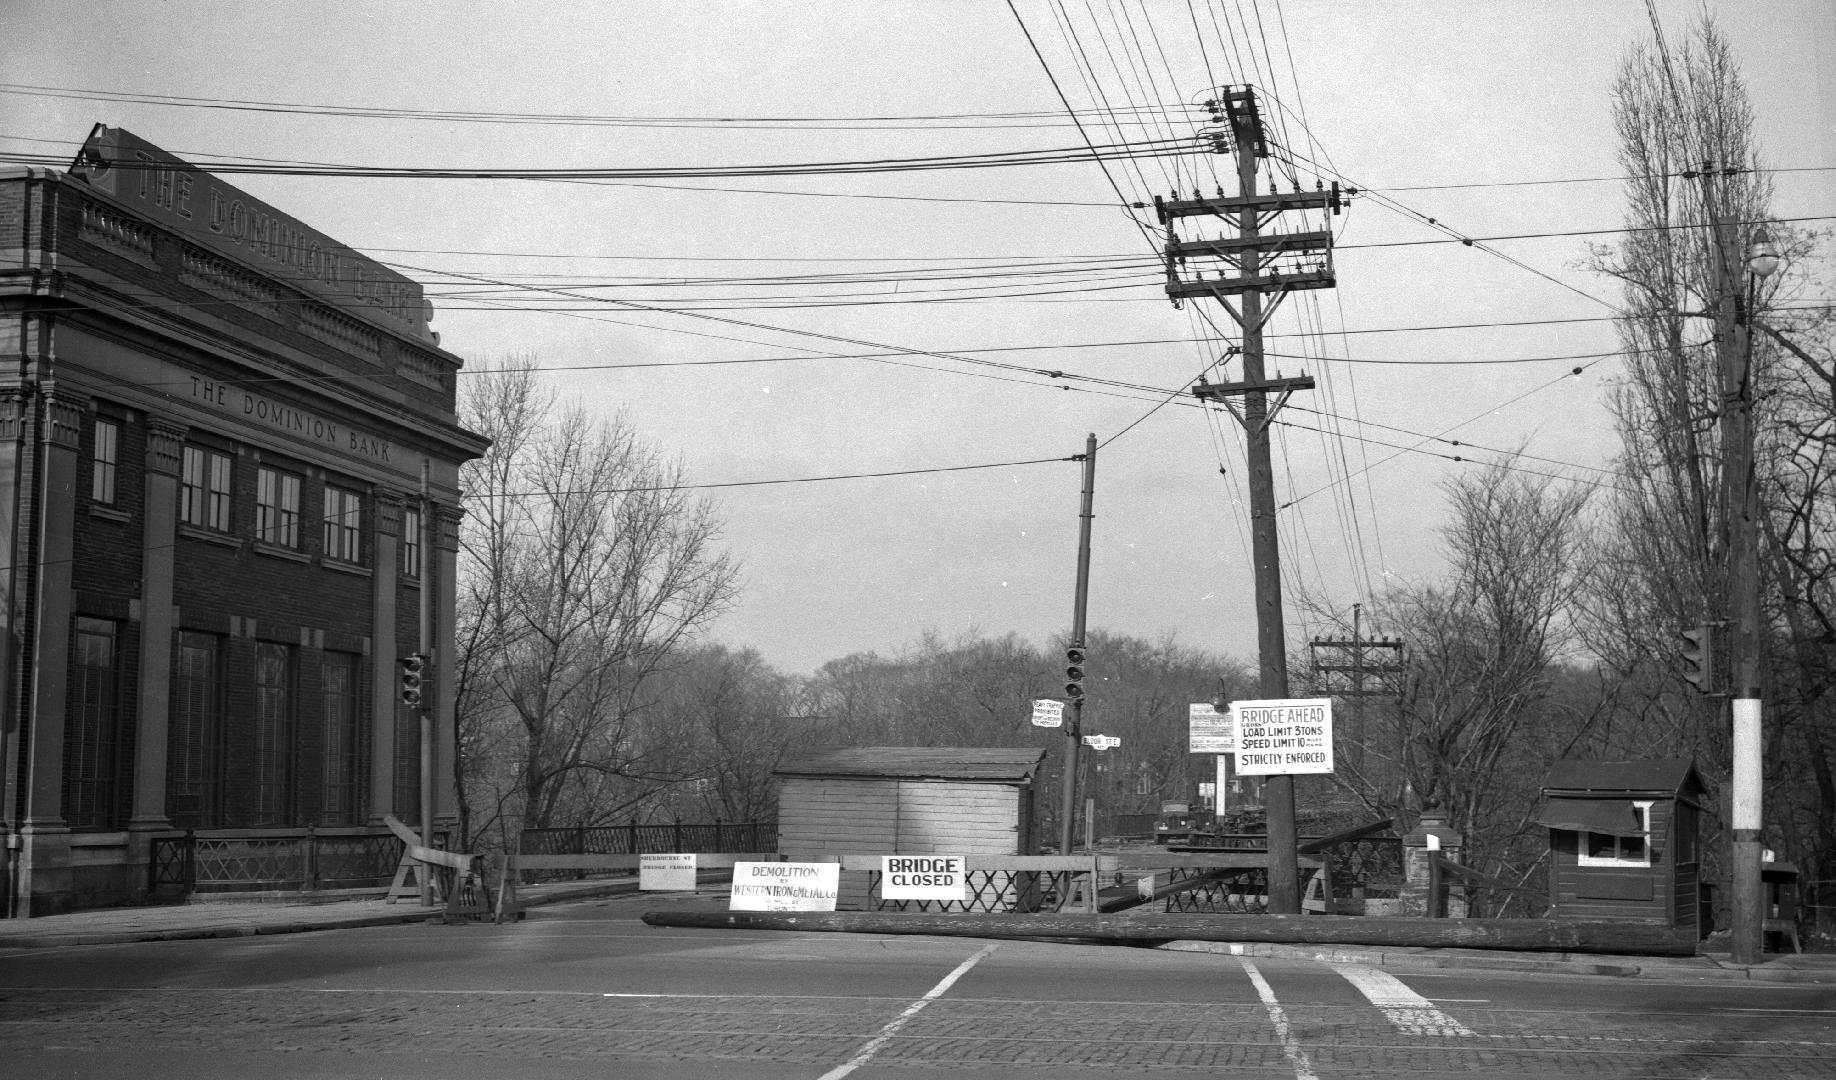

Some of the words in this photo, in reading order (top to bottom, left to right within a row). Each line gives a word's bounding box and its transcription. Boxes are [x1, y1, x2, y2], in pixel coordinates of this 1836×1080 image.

[136, 149, 194, 221] THE
[209, 186, 343, 291] DOMINION
[191, 376, 227, 405] THE
[244, 395, 337, 442] DOMINION
[349, 431, 391, 462] BANK
[1241, 709, 1285, 724] BRIDGE
[1287, 707, 1325, 723] AHEAD
[1242, 727, 1266, 738] LOAD
[1268, 726, 1293, 737] LIMIT
[1242, 739, 1270, 749] SPEED
[1273, 738, 1297, 748] LIMIT
[1298, 737, 1305, 747] 10
[1241, 753, 1282, 766] STRICTLY
[1286, 752, 1326, 764] ENFORCED
[752, 866, 819, 877] DEMOLITION
[888, 858, 959, 873] BRIDGE
[892, 874, 954, 886] CLOSED
[773, 885, 793, 897] IRON
